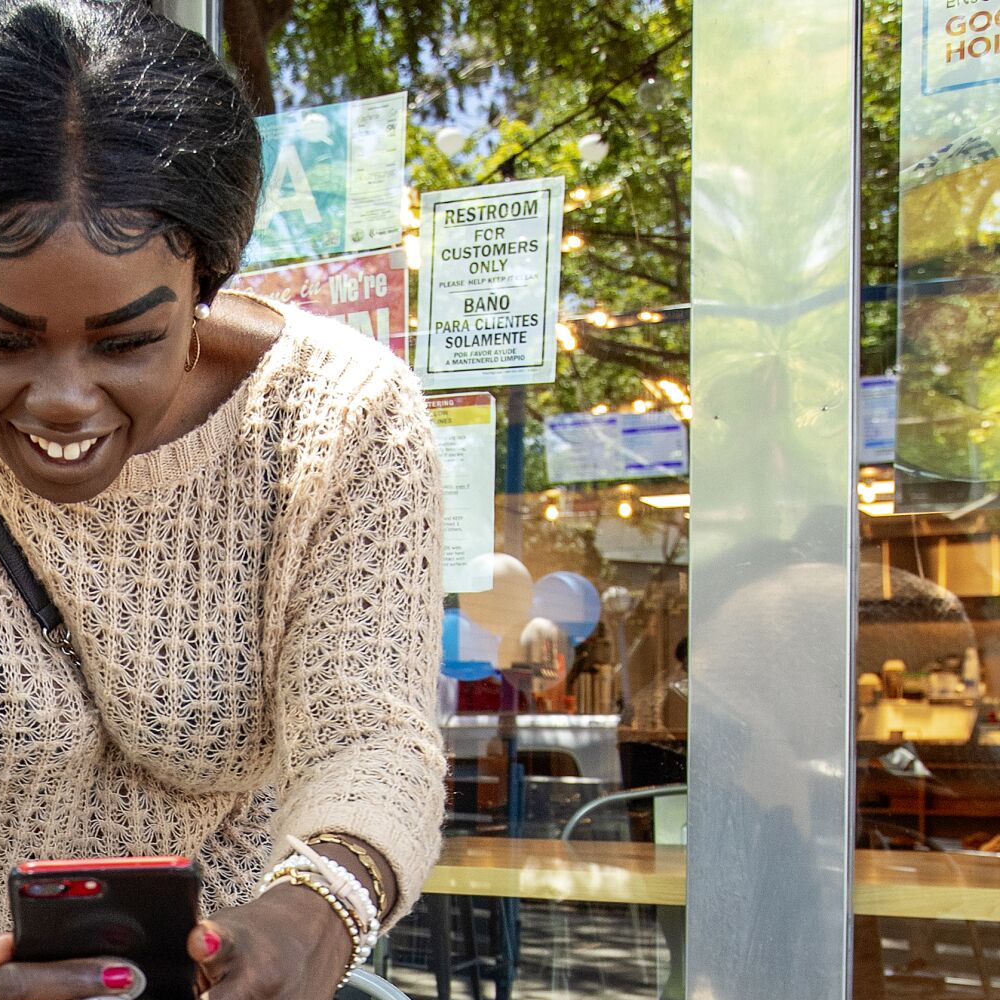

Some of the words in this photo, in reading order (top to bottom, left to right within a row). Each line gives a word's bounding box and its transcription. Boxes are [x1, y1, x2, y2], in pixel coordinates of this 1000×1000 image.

[945, 10, 1000, 37] GO
[445, 199, 538, 225] RESTROOM
[474, 227, 505, 242] FOR
[441, 240, 539, 261] CUSTOMERS
[469, 258, 508, 275] ONLY
[328, 272, 388, 305] We're
[439, 280, 464, 288] PLEASE
[468, 278, 485, 286] HELP
[464, 292, 510, 314] BAÑO
[435, 319, 470, 334] PARA
[475, 314, 539, 331] CLIENTES
[445, 331, 527, 349] SOLAMENTE
[452, 356, 500, 365] MANTENERLO
[500, 354, 526, 362] LIMPIO
[470, 349, 492, 357] FAVOR
